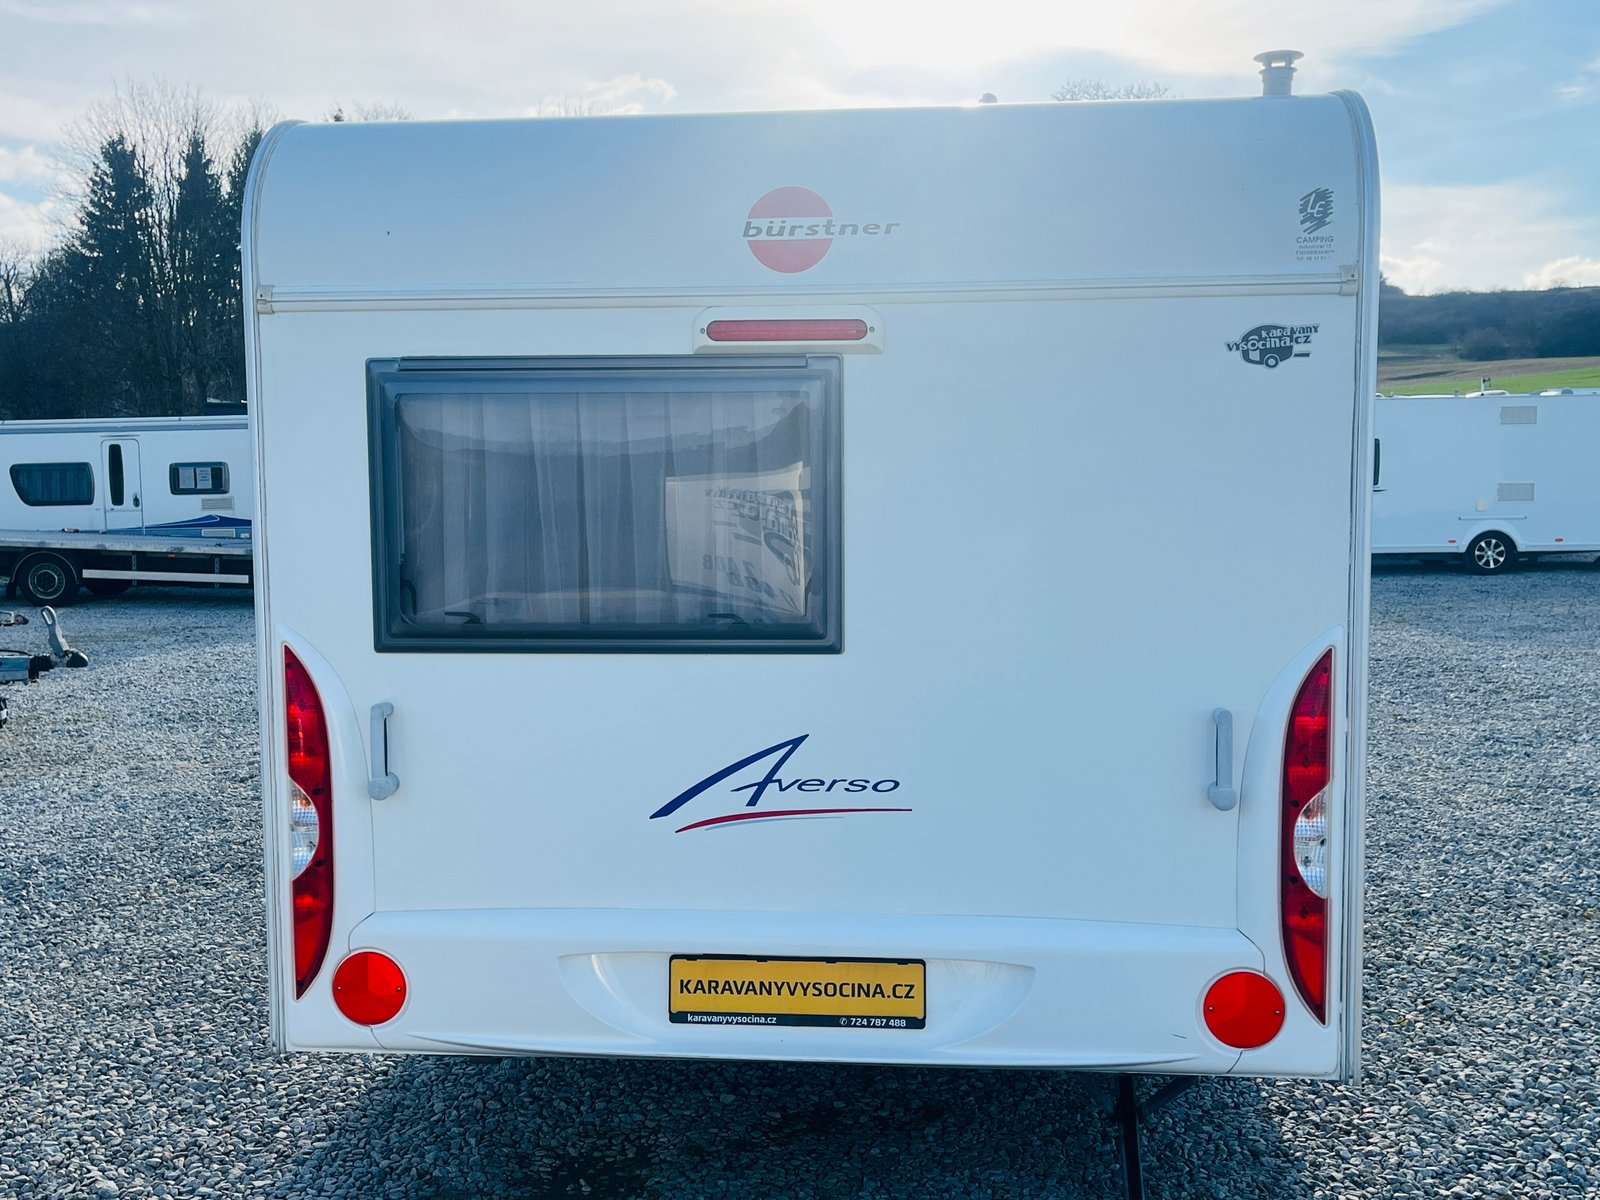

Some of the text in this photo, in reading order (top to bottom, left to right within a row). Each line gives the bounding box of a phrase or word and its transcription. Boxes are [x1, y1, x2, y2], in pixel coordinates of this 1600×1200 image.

[743, 218, 901, 238] bürstner
[1296, 235, 1334, 244] CAMPING
[649, 733, 901, 820] Averso
[679, 978, 915, 999] KARAVANYVYSOCINA.CZ
[687, 1013, 777, 1025] karavanyvysocina.cz
[850, 1017, 907, 1027] 724 787 488
